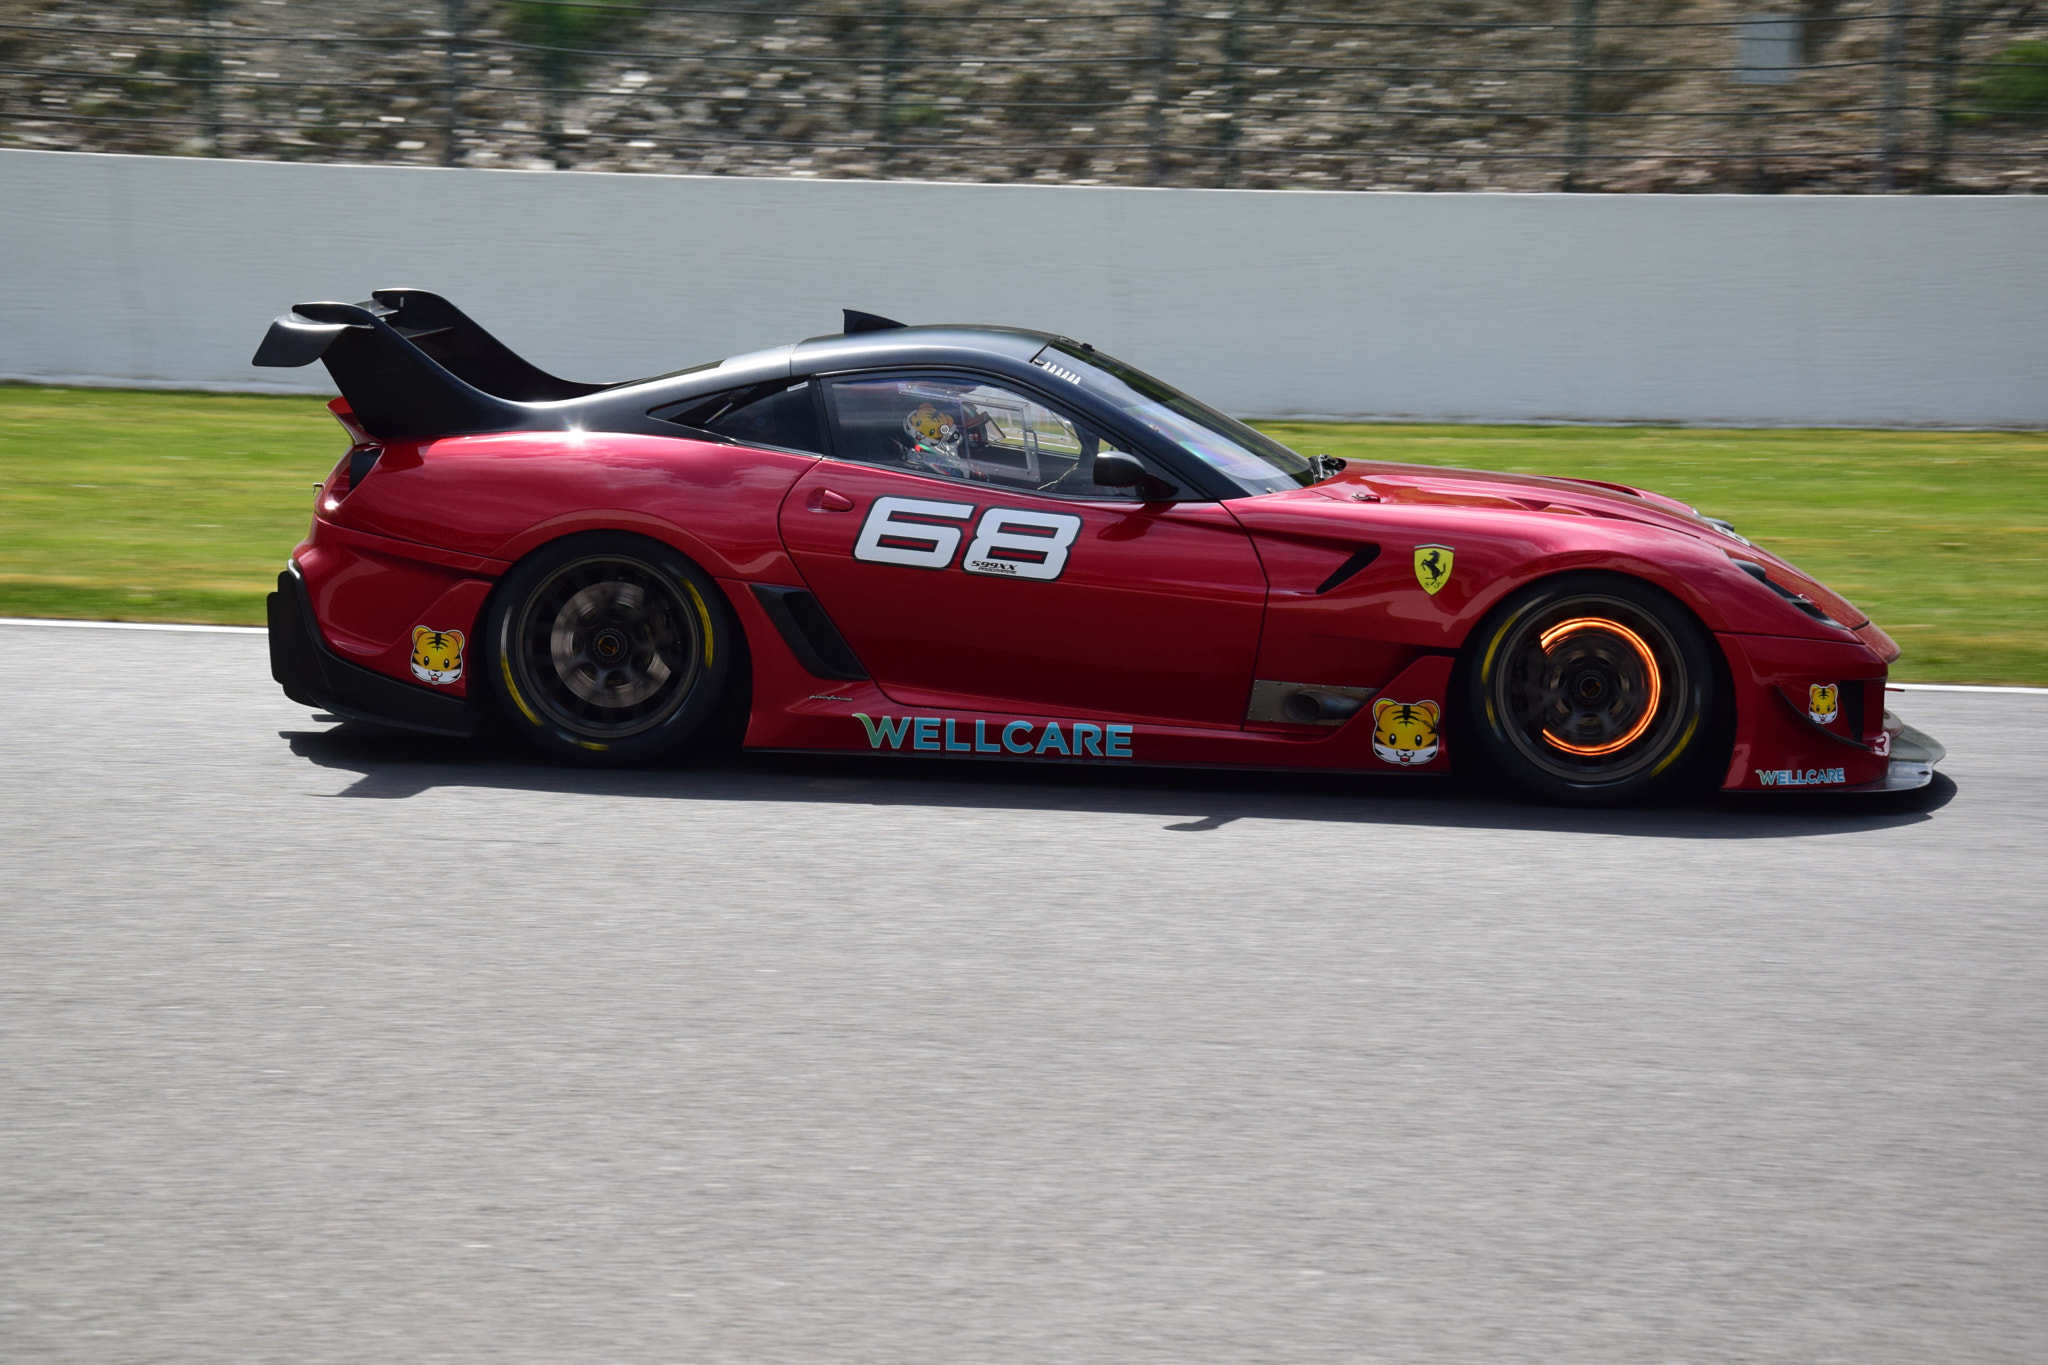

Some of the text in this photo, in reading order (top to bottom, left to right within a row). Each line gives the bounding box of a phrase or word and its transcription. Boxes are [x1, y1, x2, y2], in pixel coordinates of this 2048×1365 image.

[853, 495, 1083, 581] 68
[971, 560, 1017, 570] 599XX
[852, 712, 1134, 758] WELLCARE
[1755, 767, 1846, 786] WELLCARE
